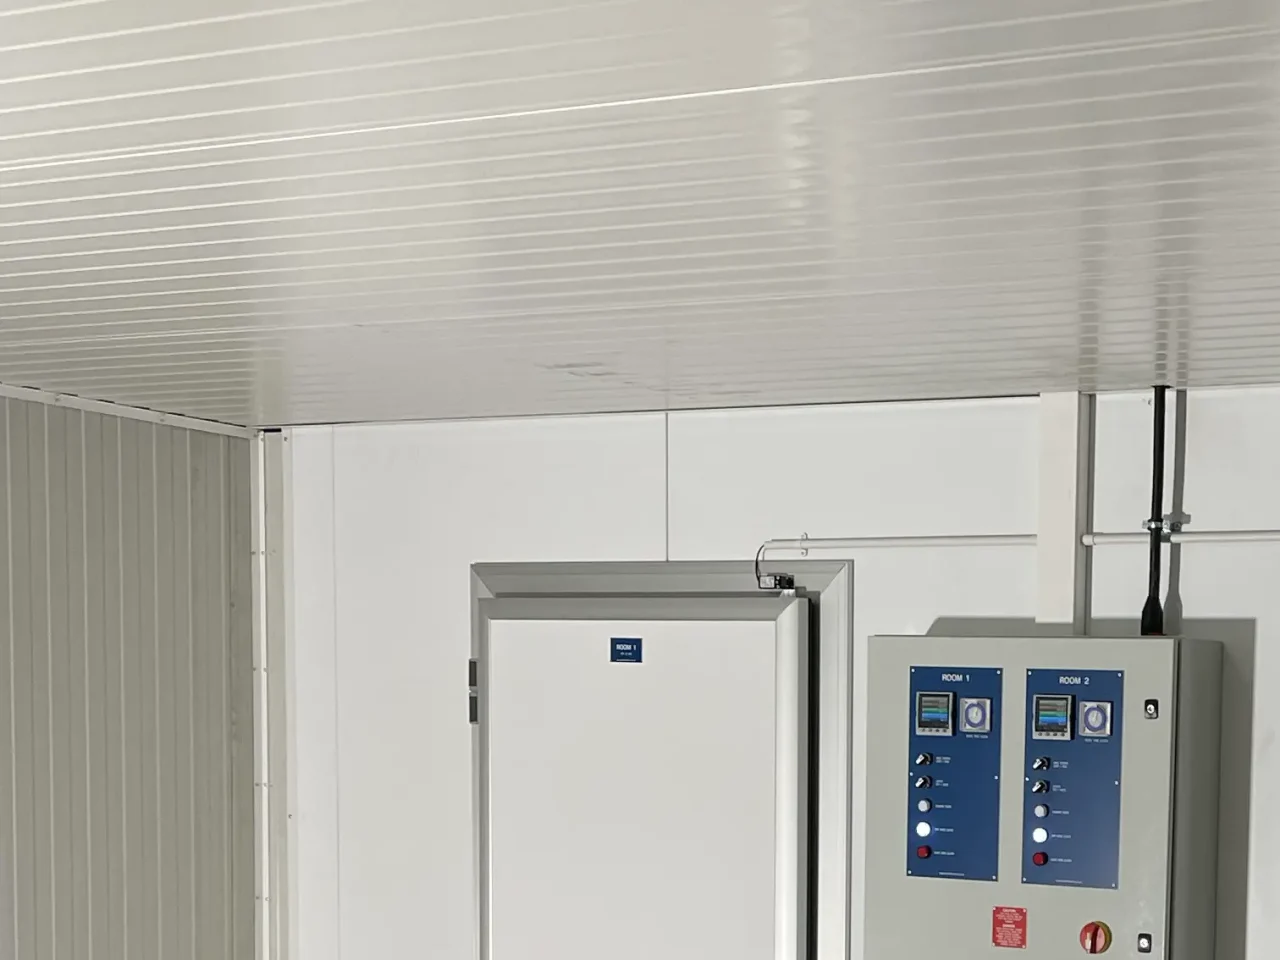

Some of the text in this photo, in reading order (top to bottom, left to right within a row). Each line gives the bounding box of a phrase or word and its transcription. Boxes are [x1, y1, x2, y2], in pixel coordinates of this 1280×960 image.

[941, 673, 970, 682] ROOM 1
[1059, 676, 1090, 685] ROOM 2
